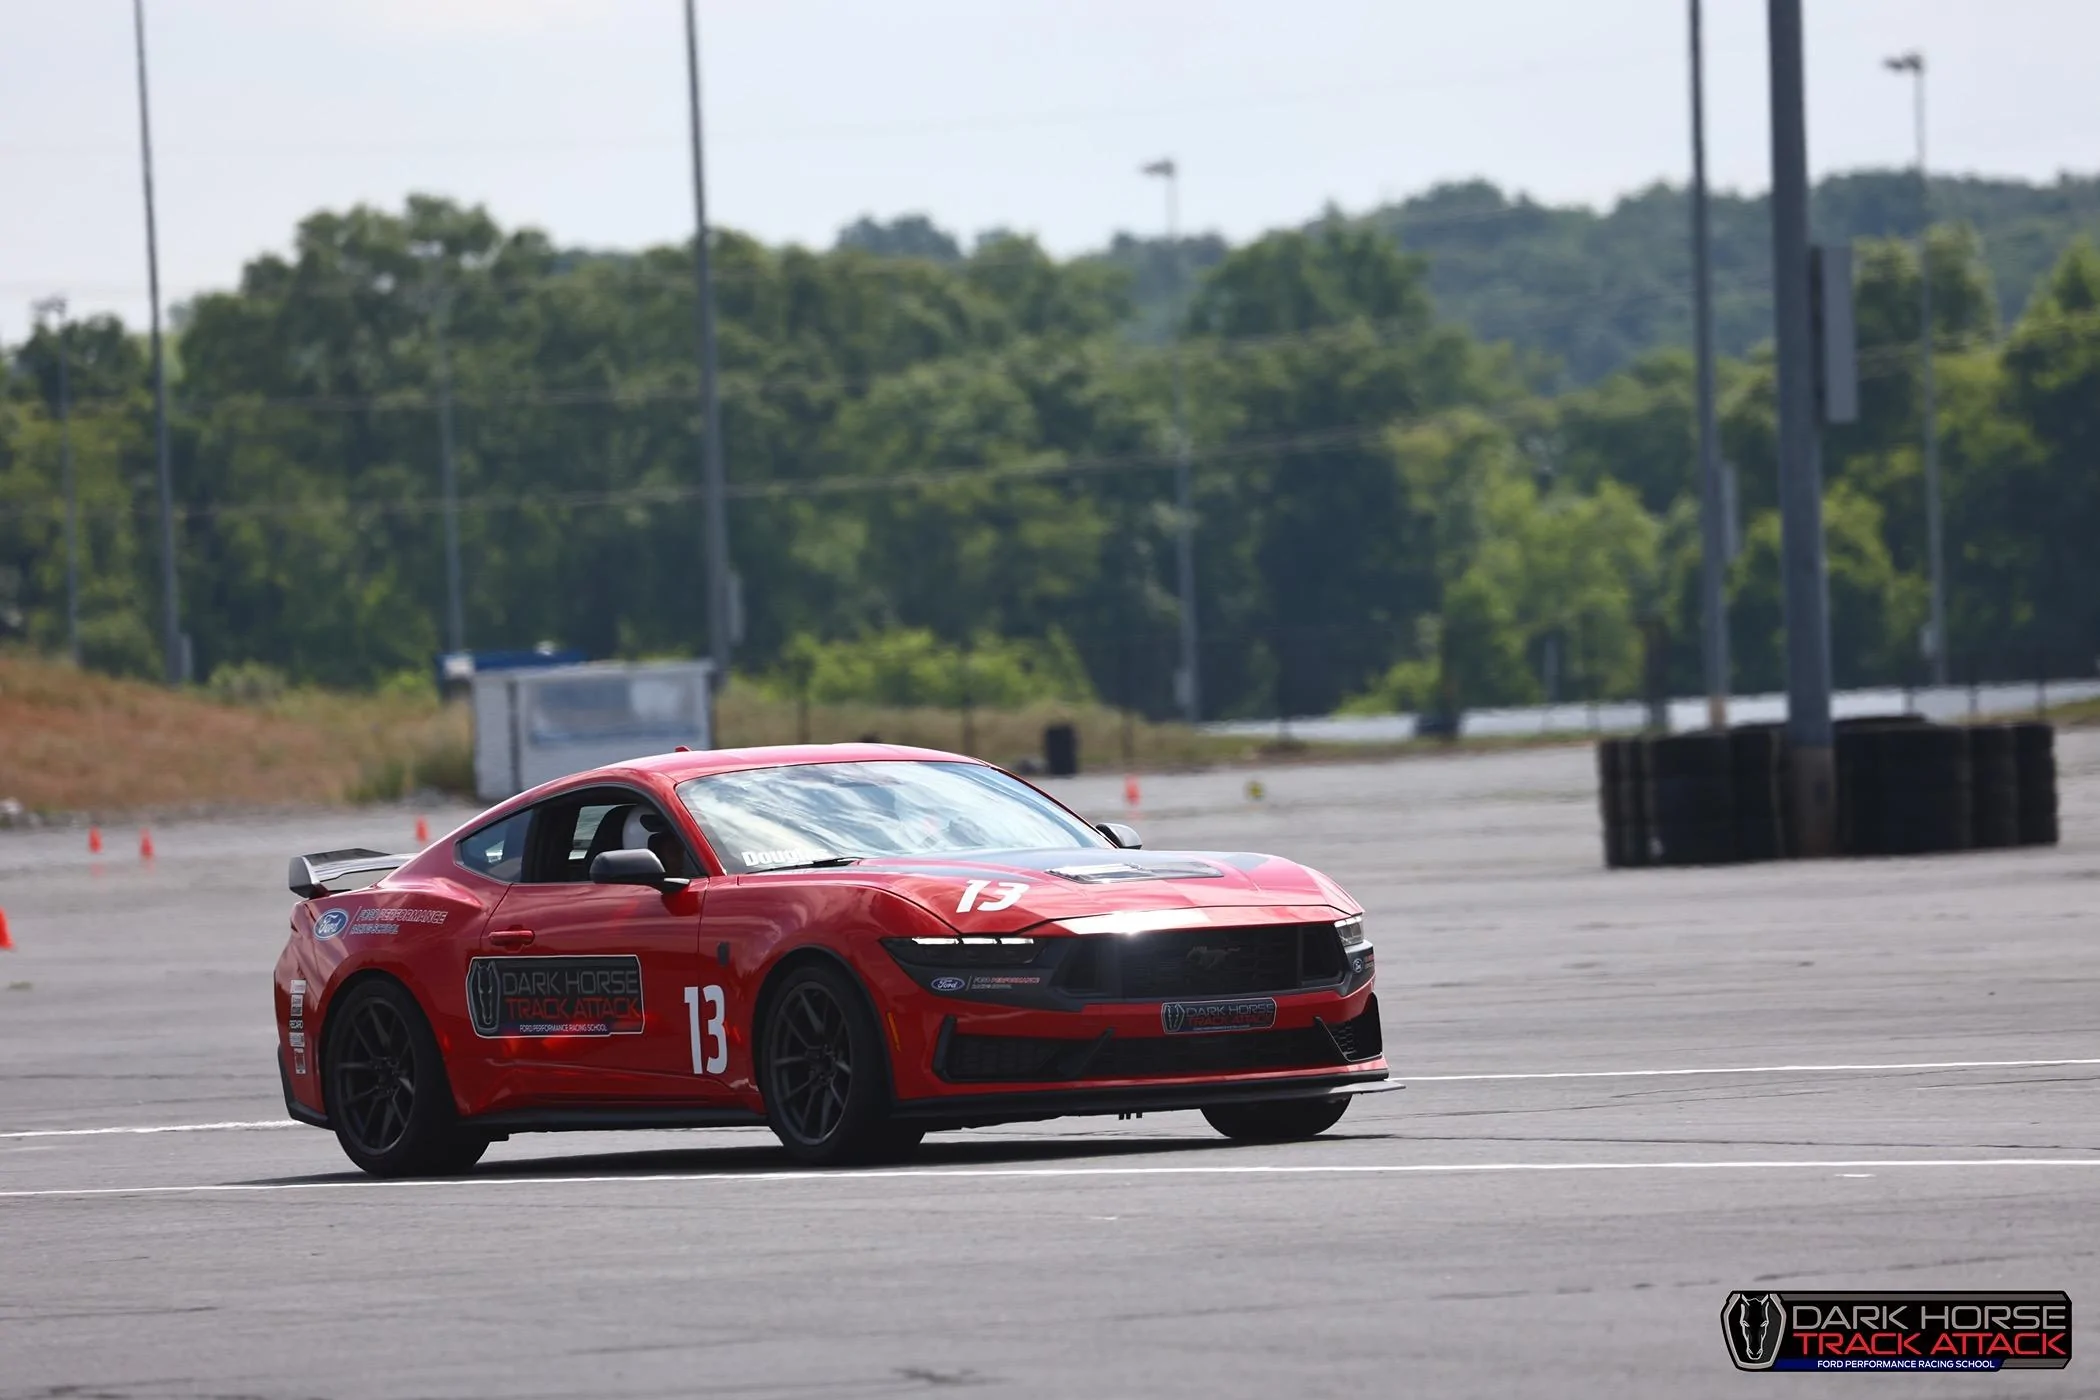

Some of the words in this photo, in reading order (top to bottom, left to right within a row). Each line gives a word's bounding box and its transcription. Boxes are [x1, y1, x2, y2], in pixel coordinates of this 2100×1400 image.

[956, 879, 1030, 913] 13
[376, 908, 448, 924] PERFORMANCE
[502, 972, 560, 995] DARK
[565, 970, 639, 994] HORSE
[505, 997, 569, 1019] TRACK
[573, 997, 641, 1018] ATTACK
[1186, 1006, 1225, 1017] DARK
[1228, 1003, 1273, 1015] HORSE
[533, 1024, 568, 1032] PERFORMANCE
[569, 1024, 587, 1032] RACING
[587, 1023, 608, 1032] SCHOOL
[684, 984, 728, 1075] 13
